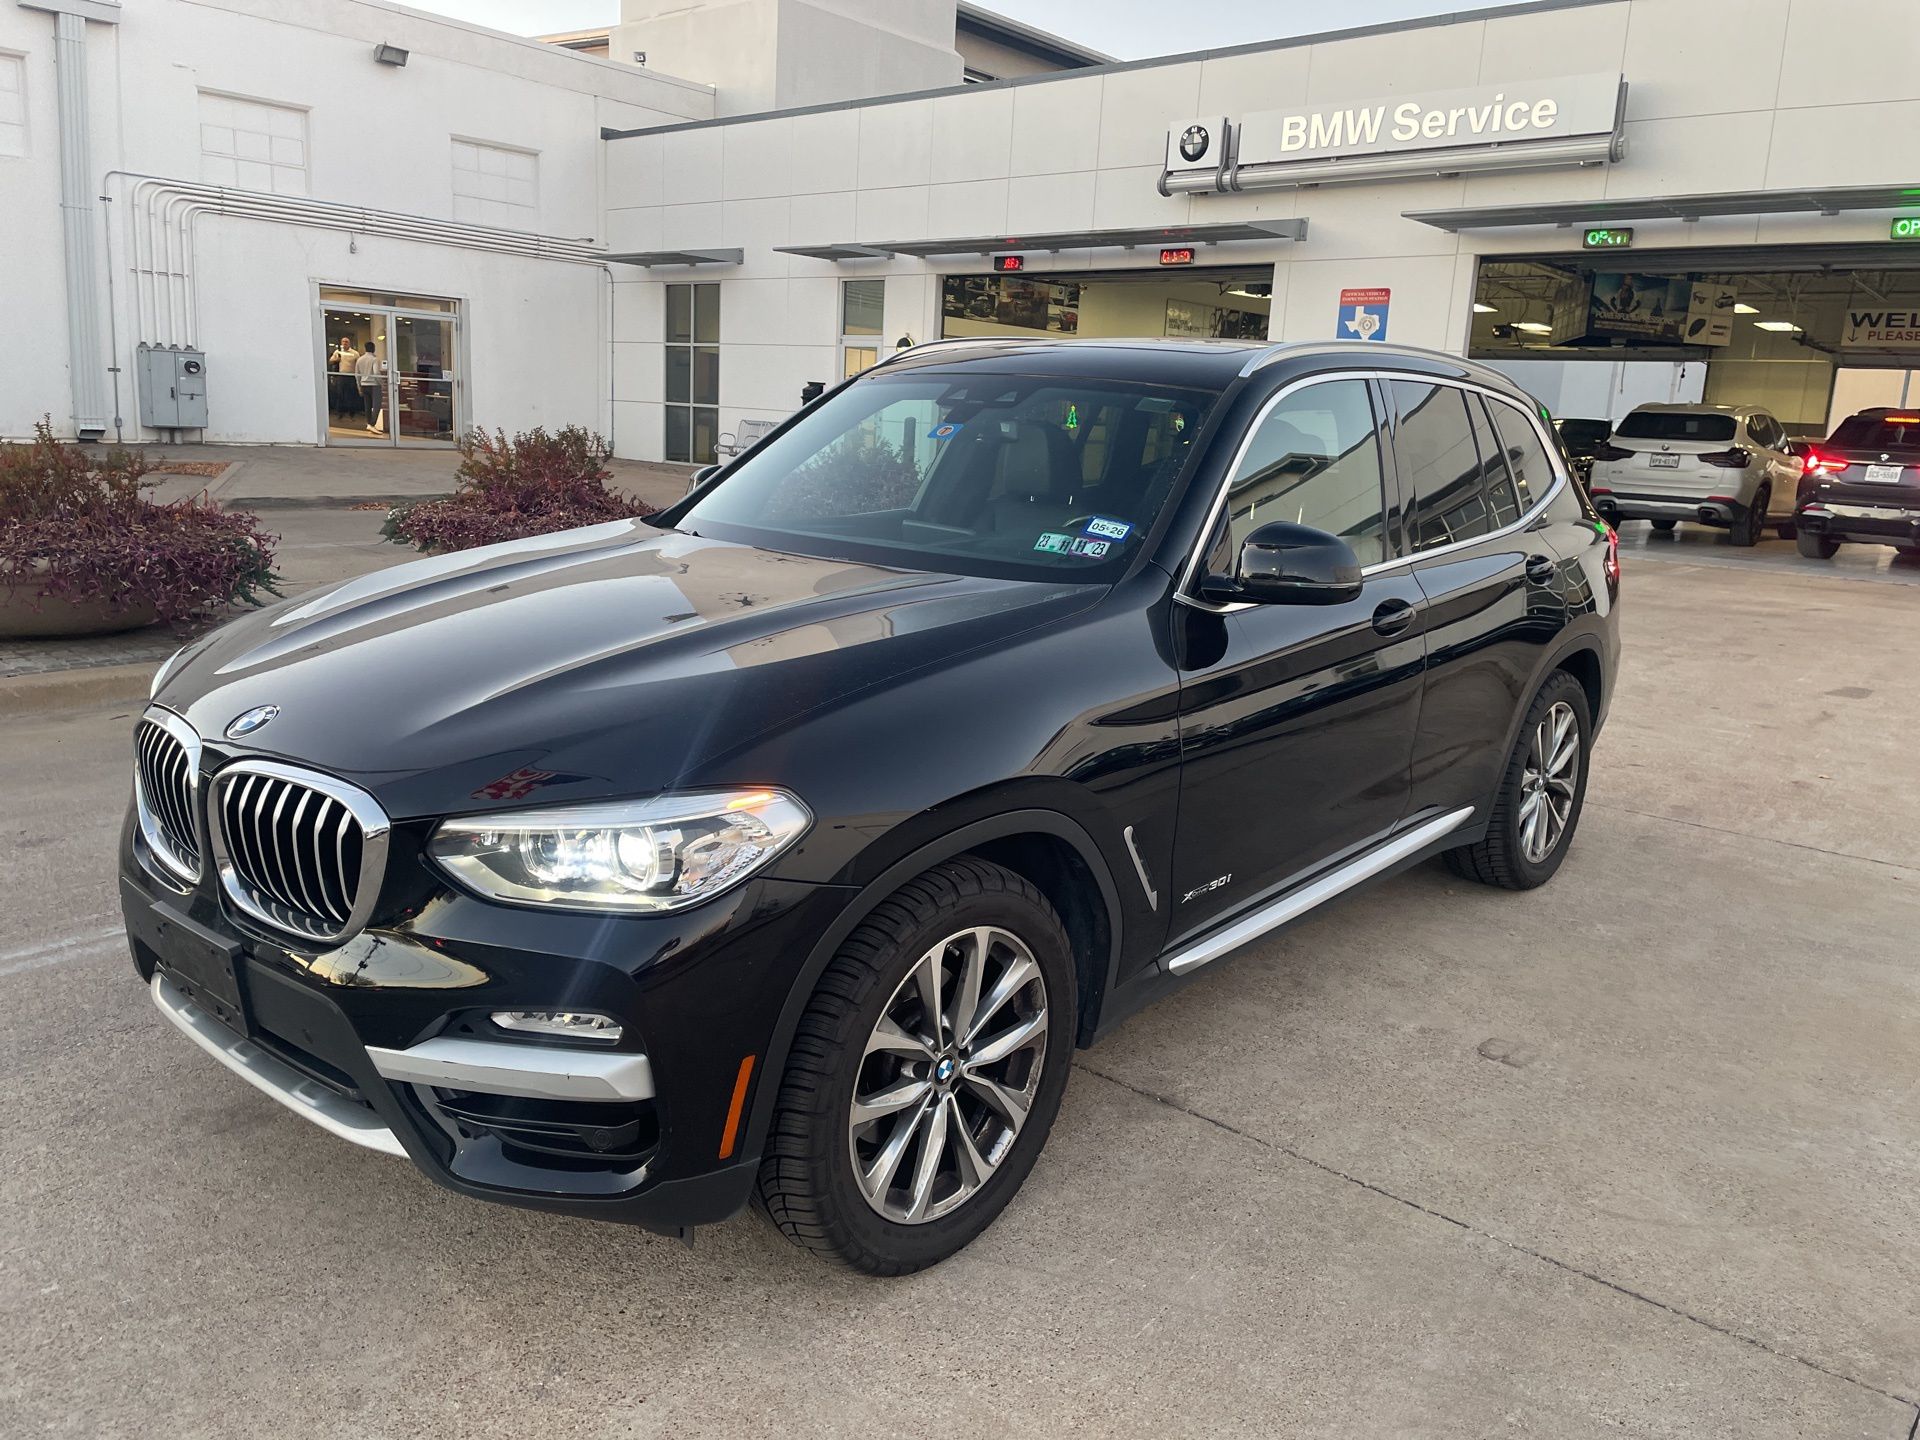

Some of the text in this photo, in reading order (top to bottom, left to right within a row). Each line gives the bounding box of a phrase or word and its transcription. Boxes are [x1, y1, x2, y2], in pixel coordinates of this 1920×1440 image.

[1280, 93, 1558, 152] BMW Service
[1091, 522, 1125, 536] 05 26
[1038, 535, 1069, 552] 23 11
[1075, 539, 1106, 555] 11 23
